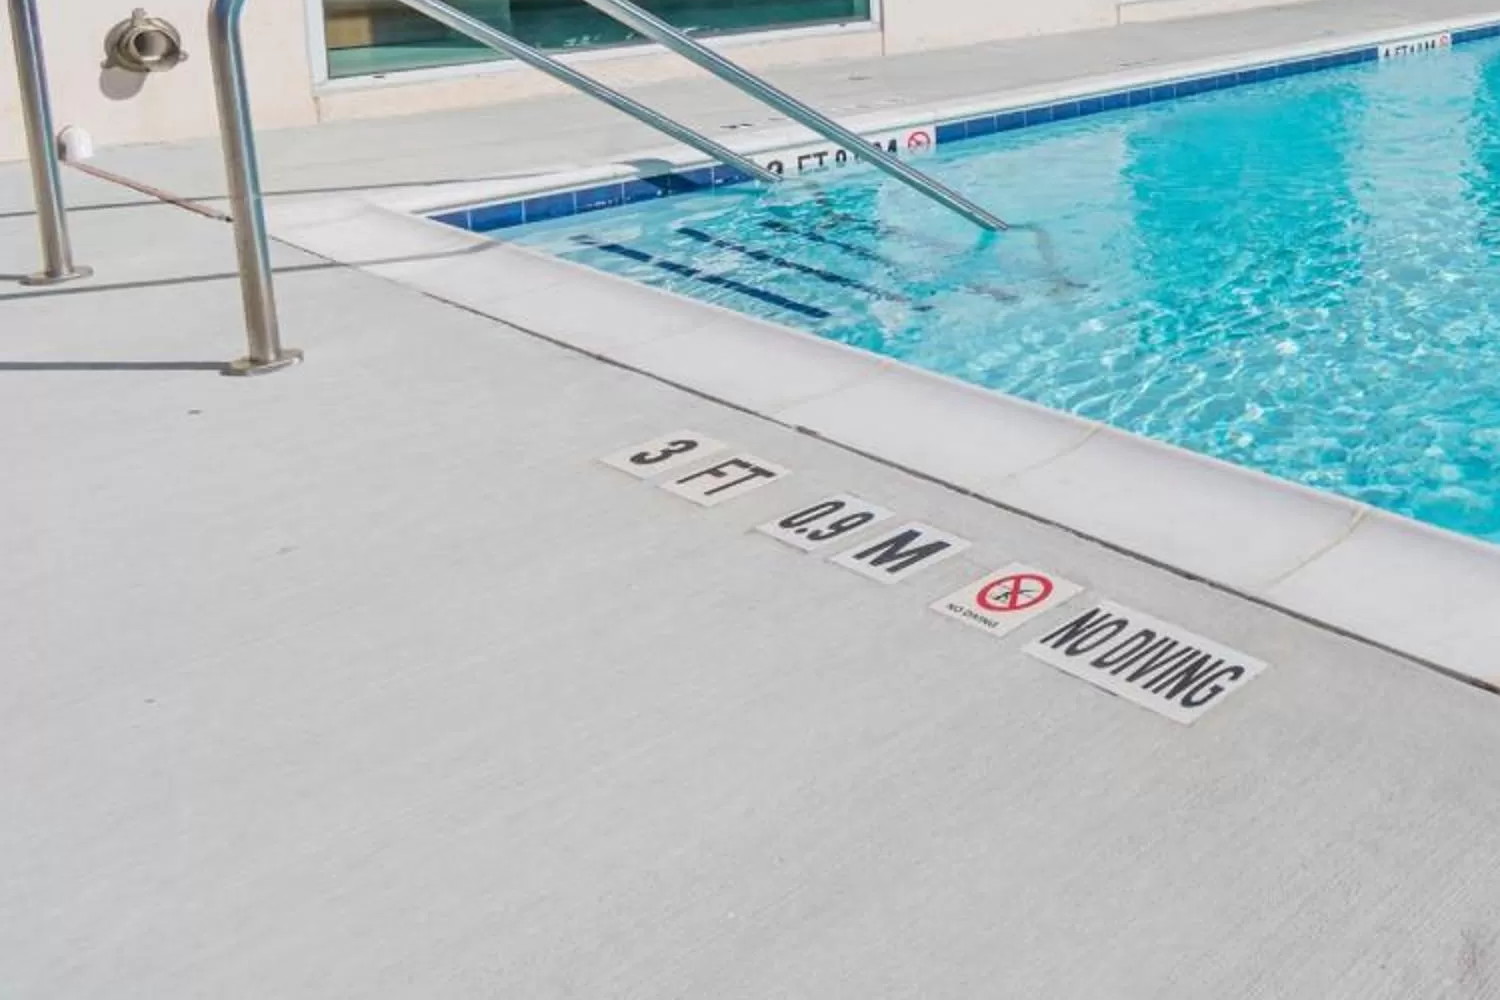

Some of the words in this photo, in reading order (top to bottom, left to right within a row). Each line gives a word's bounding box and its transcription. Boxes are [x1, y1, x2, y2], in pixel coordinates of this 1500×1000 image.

[629, 439, 698, 465] 3
[676, 457, 776, 496] FT
[778, 500, 875, 541] 0.9
[852, 528, 951, 574] M
[946, 603, 964, 613] NO
[1039, 607, 1130, 657] NO
[1089, 628, 1246, 709] DIVING
